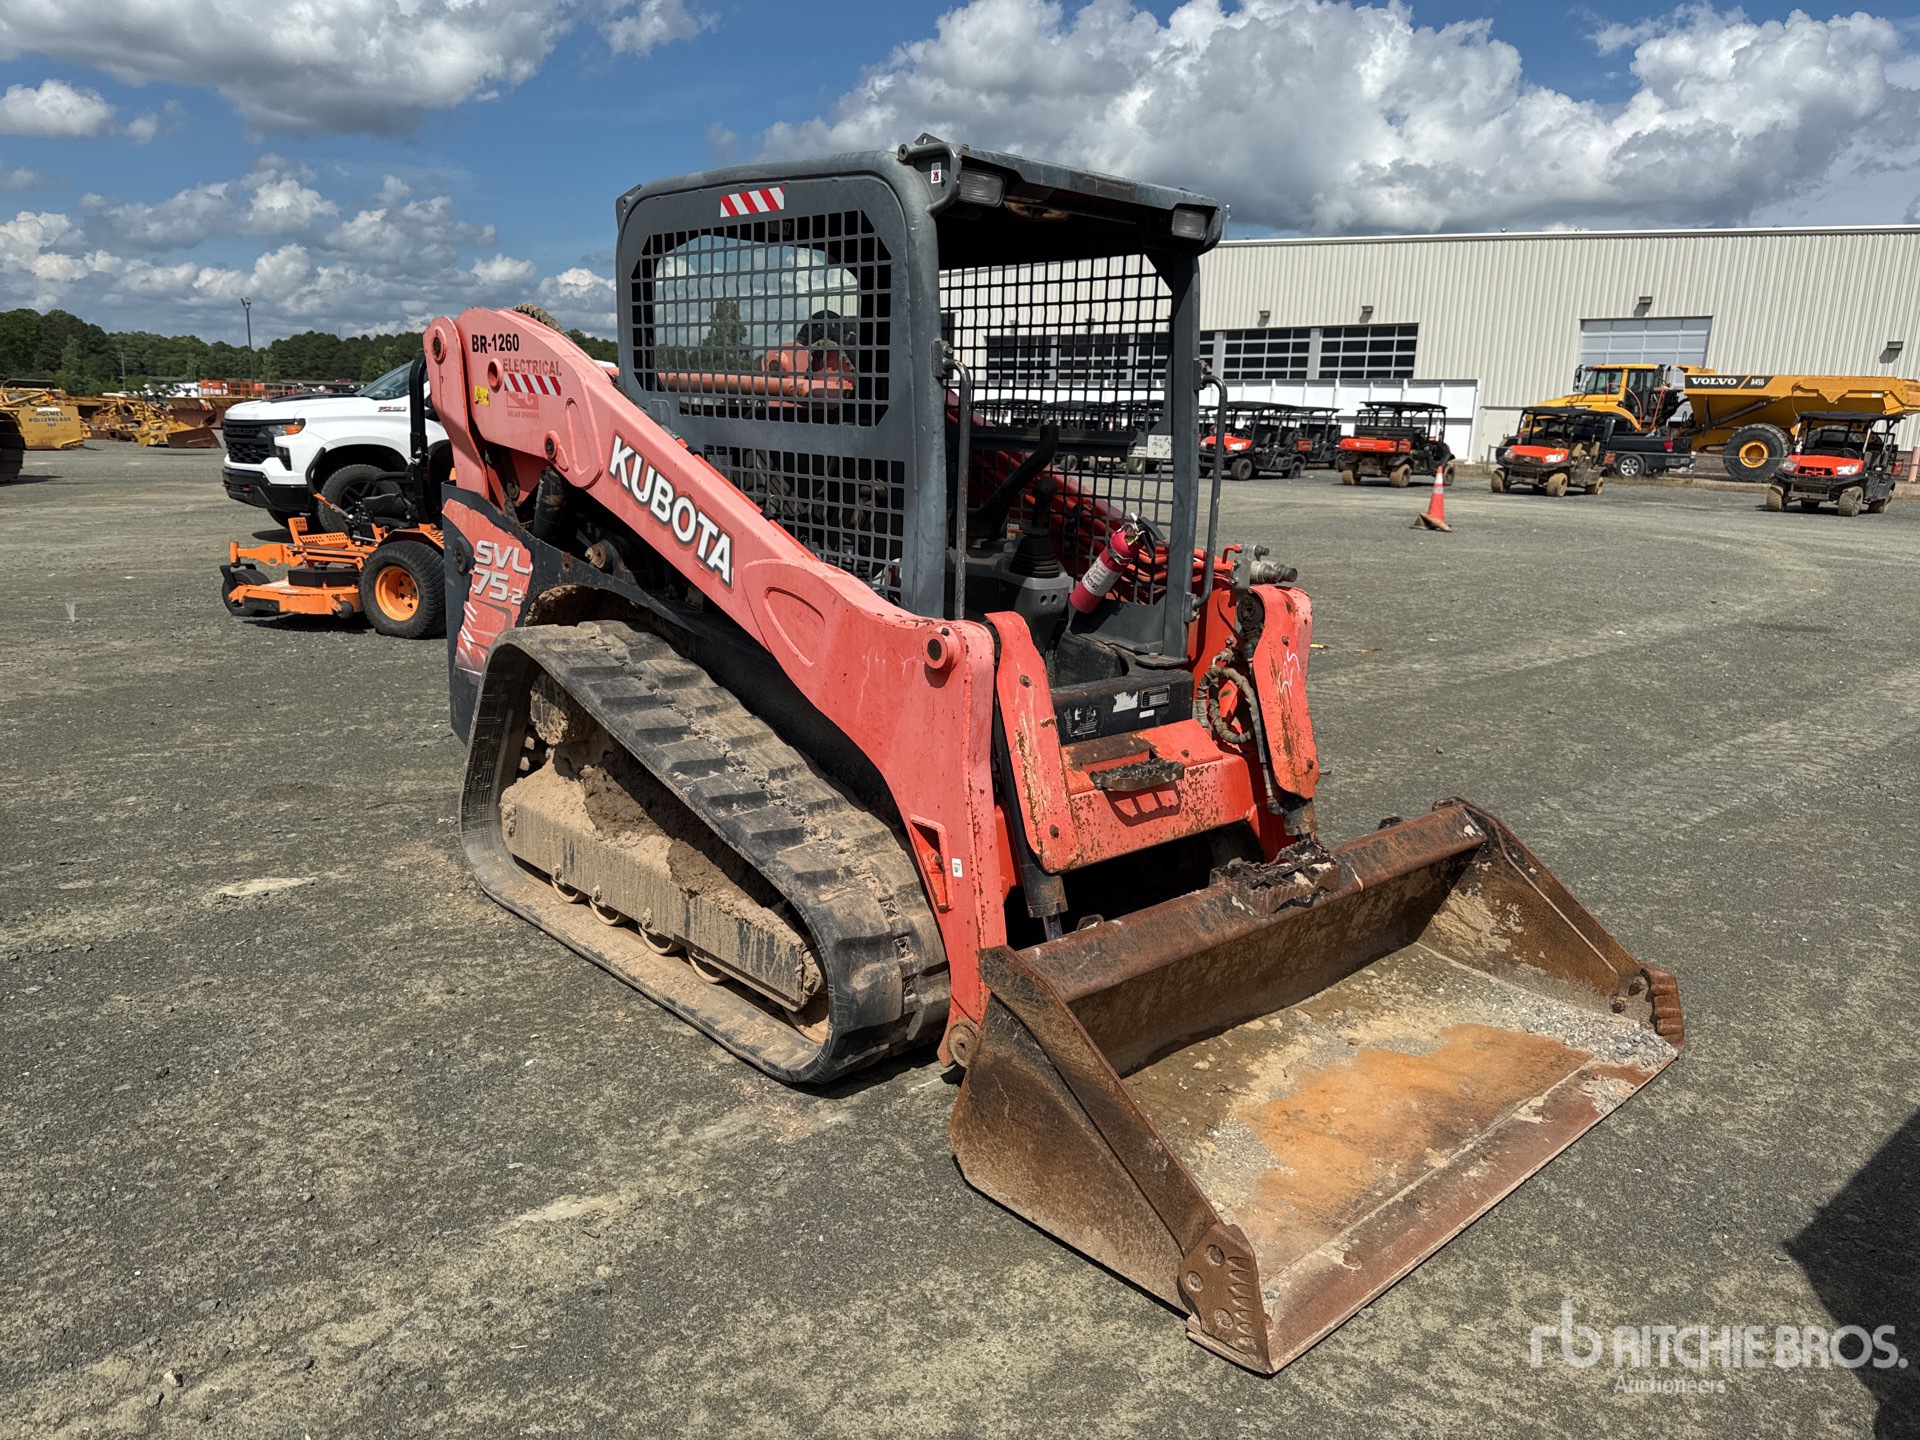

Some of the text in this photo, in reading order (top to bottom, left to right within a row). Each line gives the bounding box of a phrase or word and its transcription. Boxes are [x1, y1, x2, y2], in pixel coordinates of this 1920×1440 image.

[472, 333, 519, 354] BR-1260
[503, 358, 562, 376] ELECTRICAL
[1690, 377, 1737, 385] VOLVO
[609, 434, 731, 585] KUBOTA
[475, 540, 530, 575] SVL
